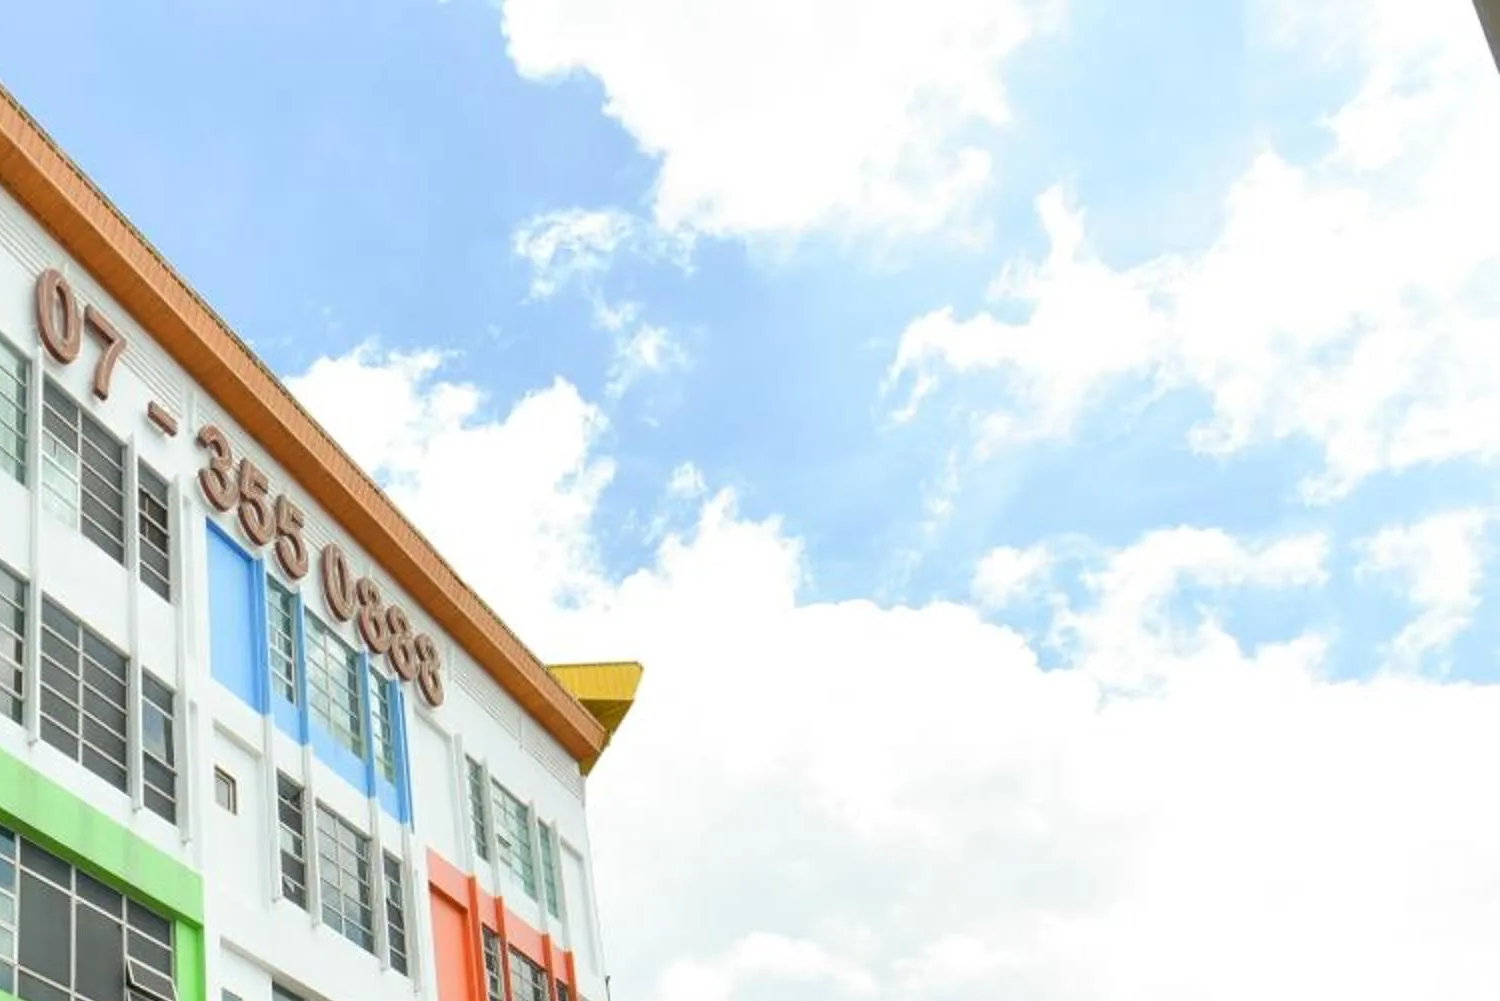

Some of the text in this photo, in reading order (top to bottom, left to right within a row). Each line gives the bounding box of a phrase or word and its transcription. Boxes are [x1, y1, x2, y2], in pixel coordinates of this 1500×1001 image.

[35, 267, 128, 401] 07
[196, 424, 310, 581] 355
[320, 542, 446, 707] 0888
